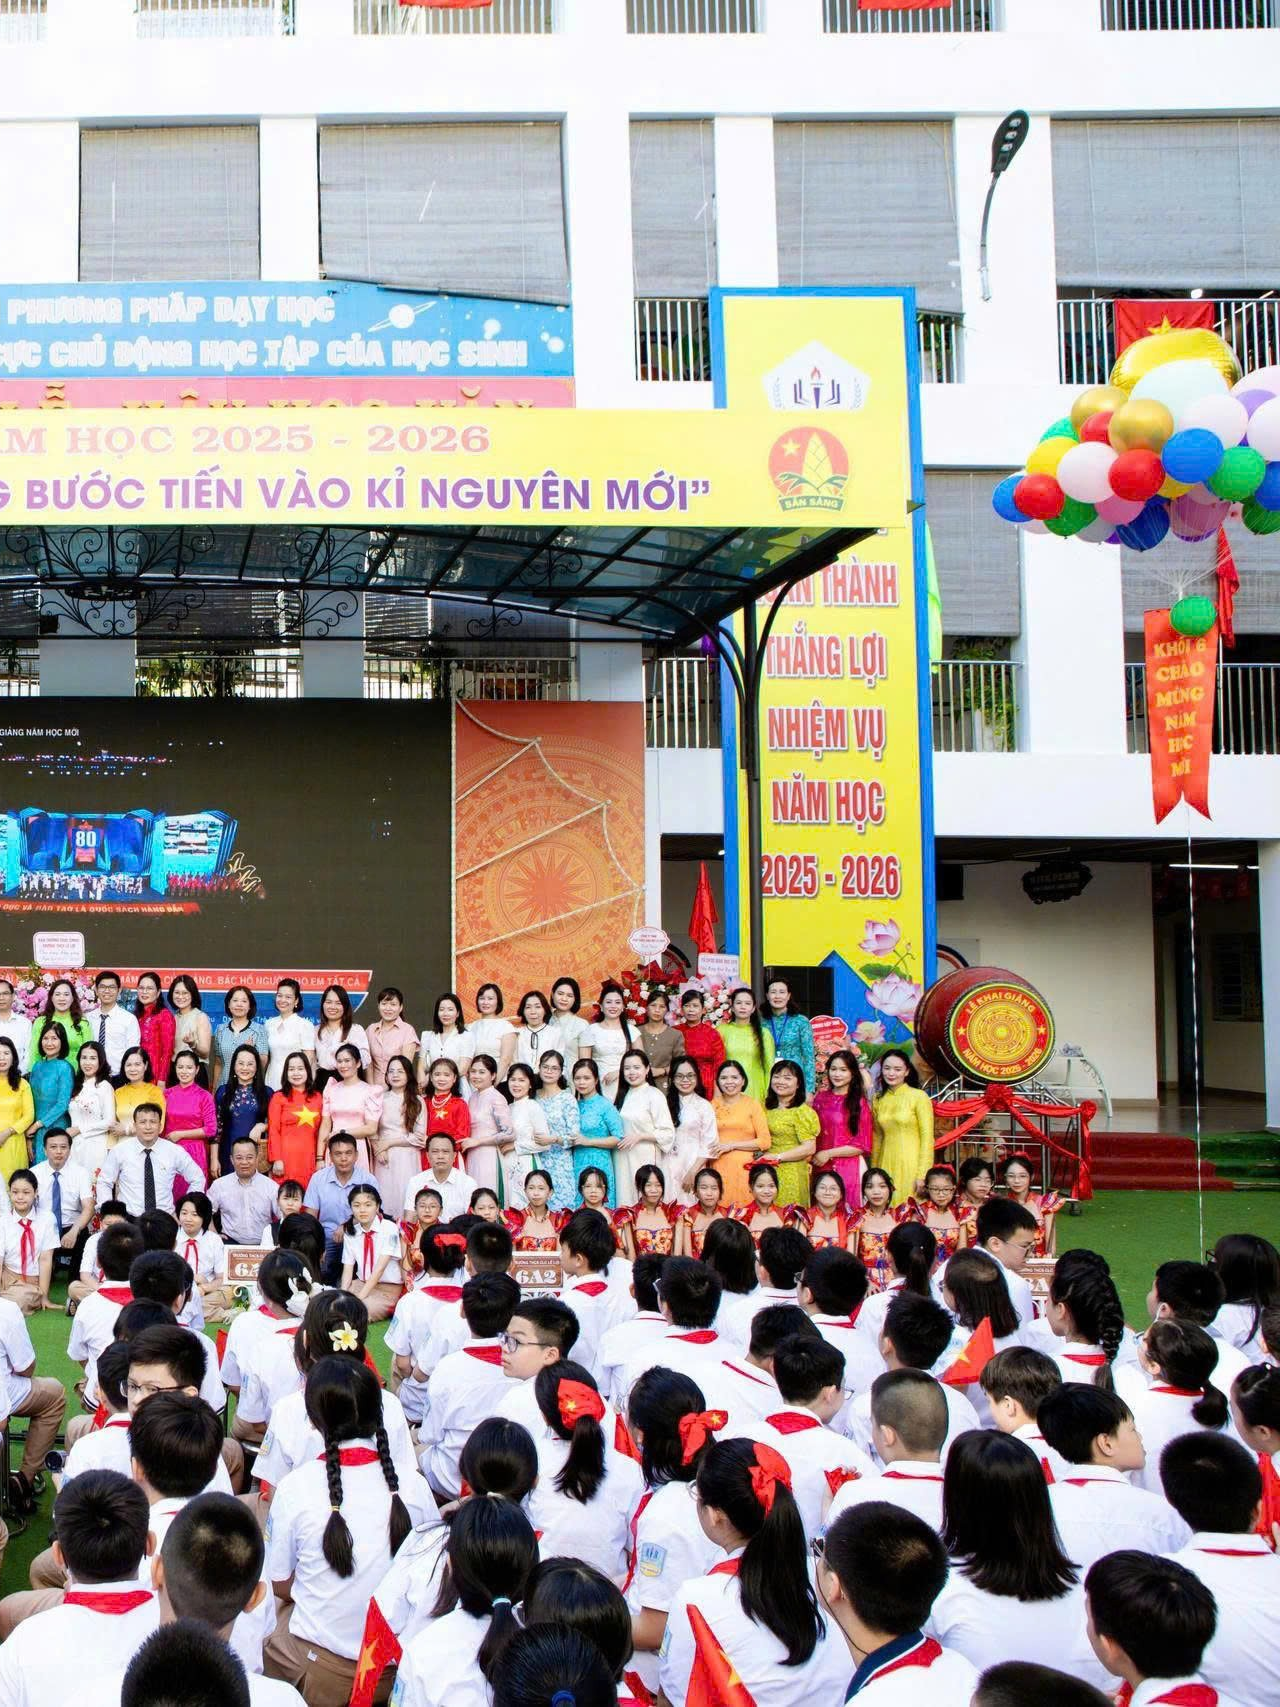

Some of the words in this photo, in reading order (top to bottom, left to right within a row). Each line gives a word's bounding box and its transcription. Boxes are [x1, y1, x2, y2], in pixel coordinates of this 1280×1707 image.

[277, 296, 335, 327] HỌC
[200, 339, 258, 372] HỌC
[326, 333, 386, 367] CỦA
[392, 339, 450, 372] HỌC
[458, 340, 528, 367] SINH
[67, 426, 173, 459] HỌC
[192, 424, 314, 453] 2025
[367, 425, 490, 453] 2026
[26, 471, 146, 510] BƯỚC
[159, 464, 243, 509] TIẾN
[257, 468, 351, 509] VÀO
[367, 468, 406, 509] KỈ
[420, 470, 590, 510] NGUYÊN
[821, 555, 897, 604] THÀNH
[767, 621, 841, 675] THẮNG
[849, 633, 885, 684] LỢI
[1154, 637, 1190, 658] KHỐI
[1196, 639, 1207, 652] 6
[1155, 660, 1205, 682] CHÀO
[25, 727, 44, 736] NĂM
[45, 729, 62, 738] HỌC
[64, 727, 80, 736] MỚI
[768, 700, 847, 757] NHIỆM
[853, 708, 884, 757] VỤ
[772, 773, 828, 821] NĂM
[836, 781, 883, 830] HỌC
[75, 831, 96, 848] 80
[761, 855, 817, 894] 2025
[842, 855, 899, 895] 2026
[966, 998, 978, 1014] LỄ
[977, 992, 1002, 1005] KHAI
[1004, 991, 1036, 1012] GIẢNG
[962, 1048, 981, 1069] NĂM
[979, 1064, 1000, 1076] HỌC
[1000, 1065, 1022, 1075] 2025
[1024, 1047, 1043, 1067] 2026
[234, 1262, 261, 1277] 6A
[516, 1270, 557, 1284] 6A2
